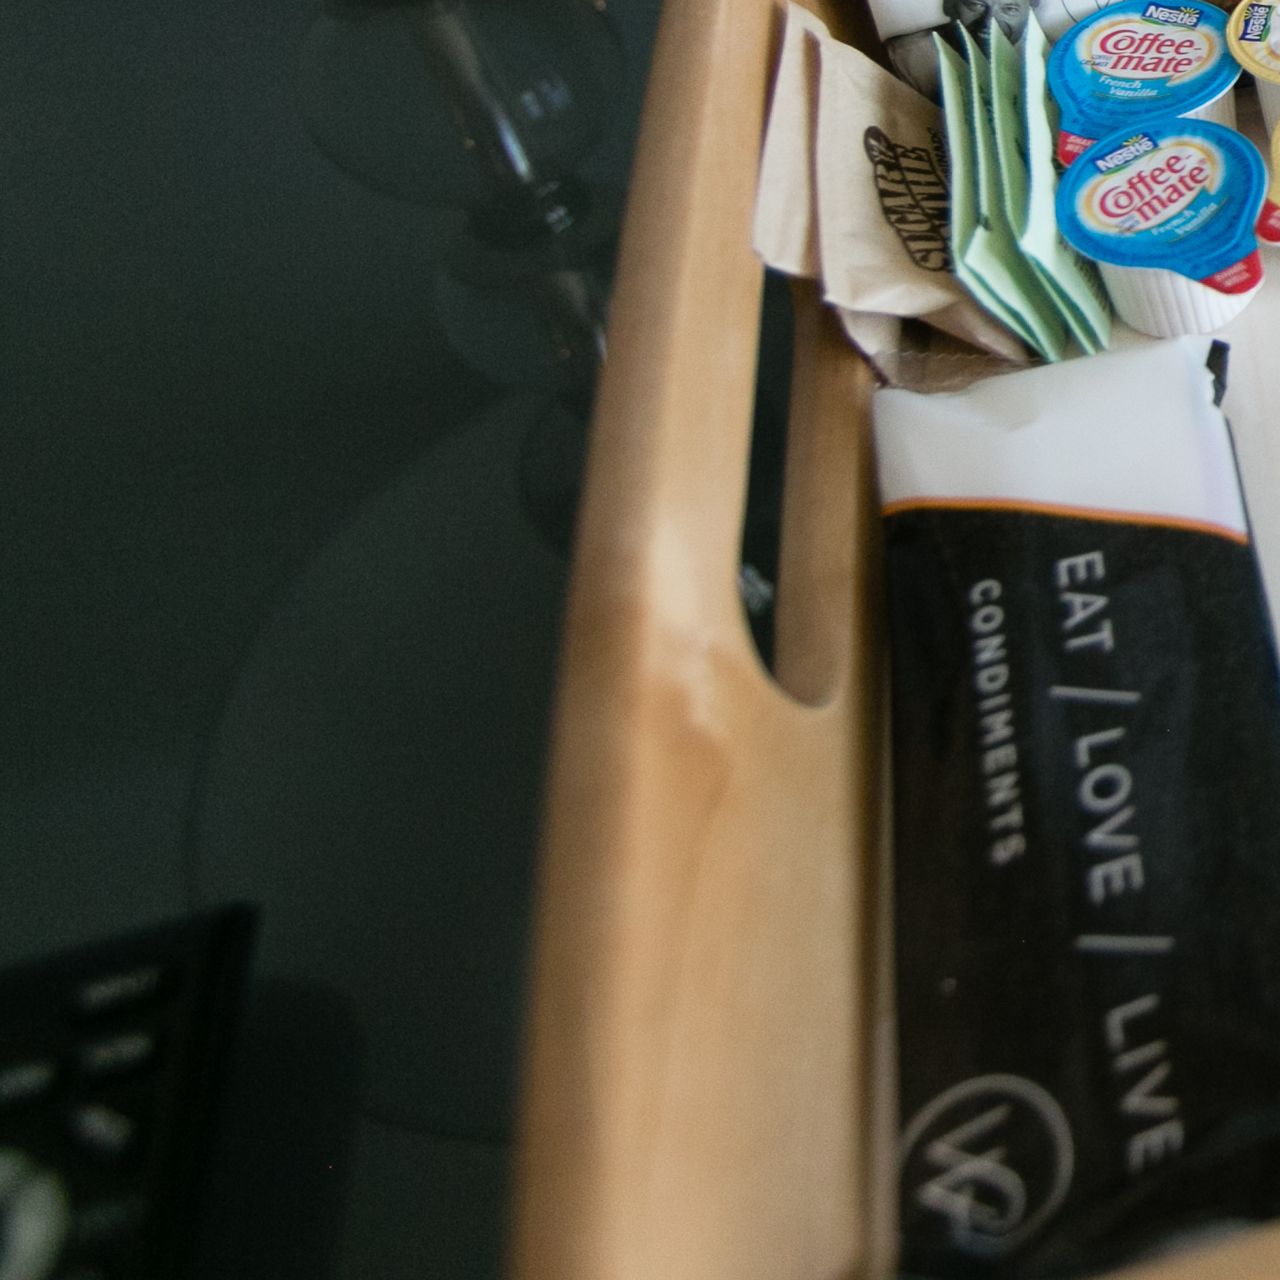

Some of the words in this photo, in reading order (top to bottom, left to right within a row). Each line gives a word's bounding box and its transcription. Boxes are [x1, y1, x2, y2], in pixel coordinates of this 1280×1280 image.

[1100, 30, 1201, 55] Coffee-
[1111, 53, 1193, 73] mate
[1099, 77, 1142, 89] French
[1110, 87, 1158, 98] Vanilla
[1100, 154, 1193, 218] Coffee-
[1136, 166, 1208, 222] mate
[1057, 550, 1114, 654] EAT
[969, 579, 1027, 865] CONDIMENTS
[1076, 727, 1144, 905] LOVE
[1106, 993, 1184, 1171] LIVE
